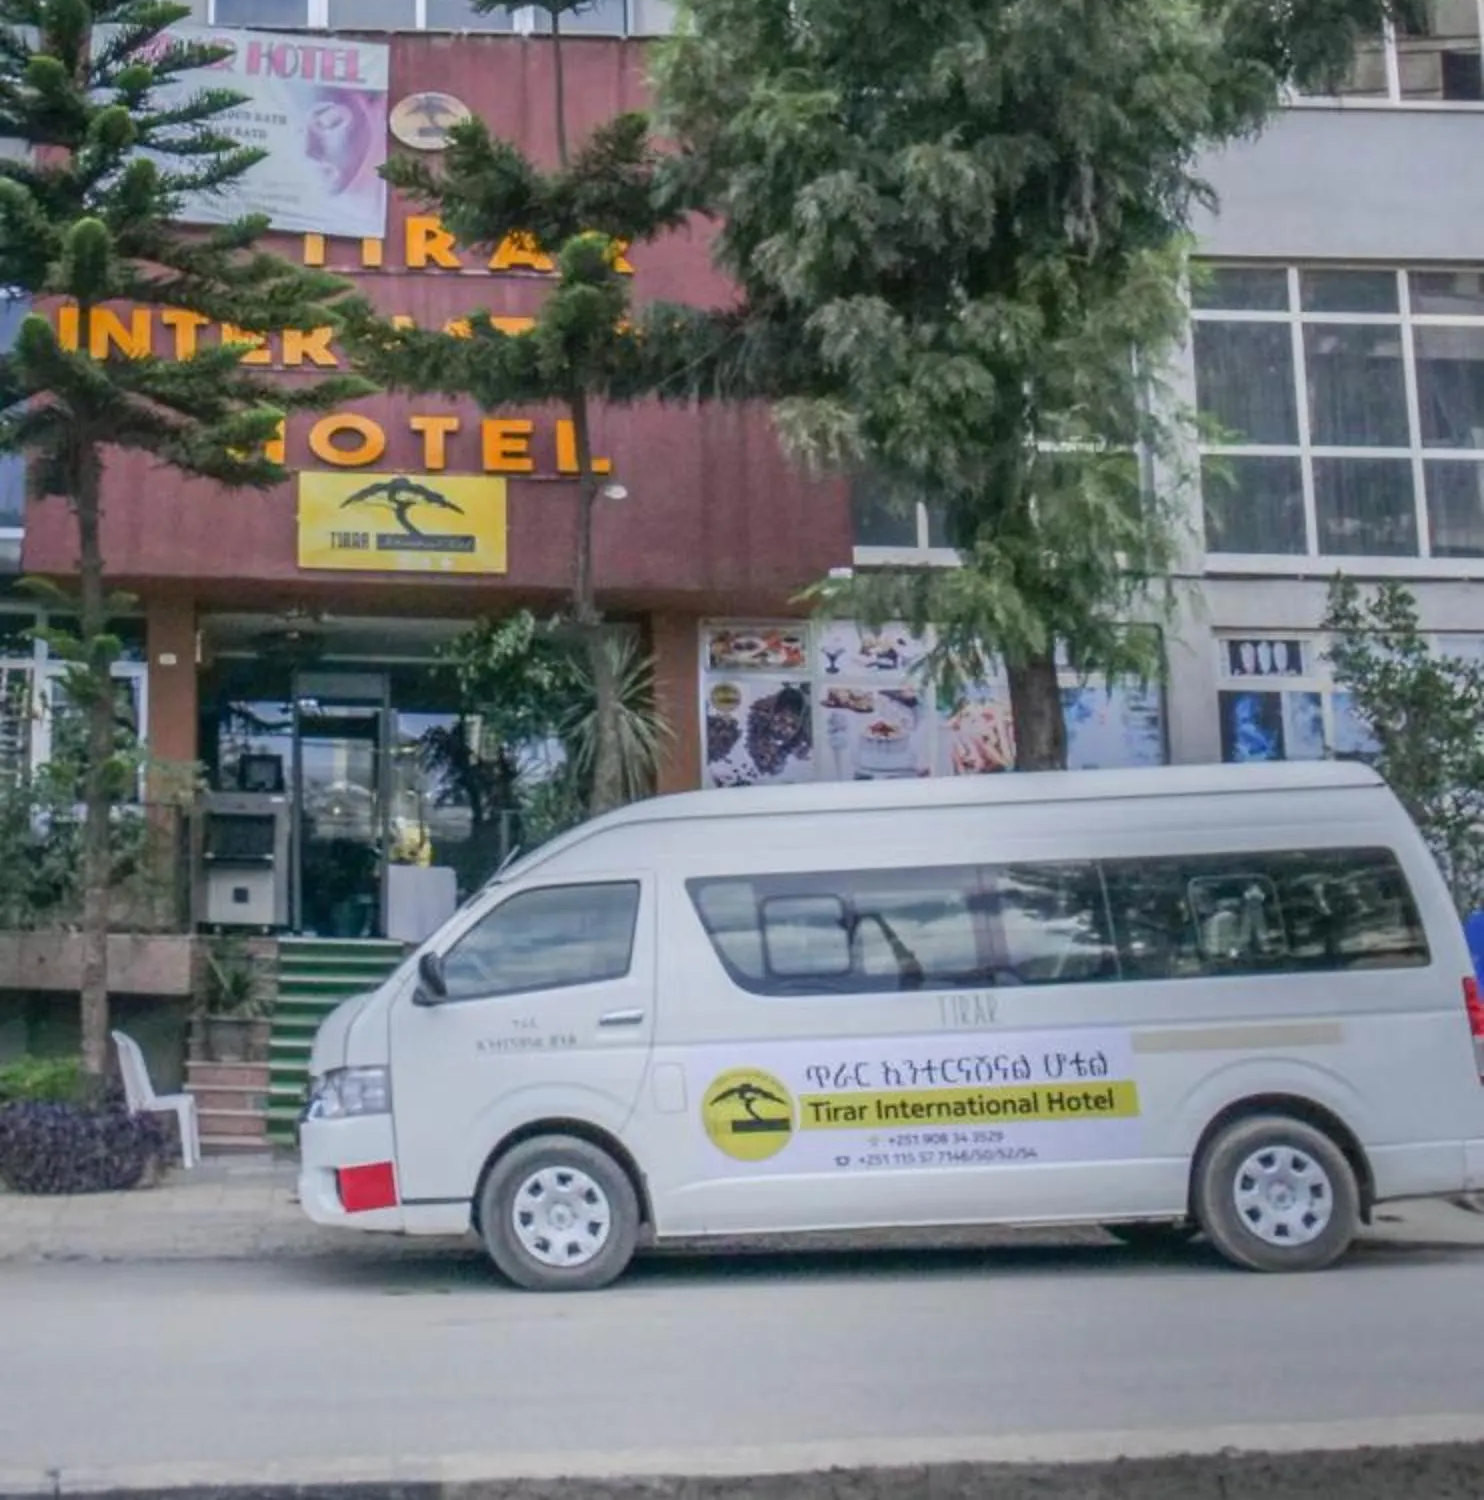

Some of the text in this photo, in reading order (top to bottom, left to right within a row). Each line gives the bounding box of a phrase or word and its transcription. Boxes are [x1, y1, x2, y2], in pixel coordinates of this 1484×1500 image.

[245, 40, 367, 84] HOTEL
[936, 993, 998, 1027] TIRAR
[807, 1087, 1115, 1122] Tirar International Hotel
[888, 1133, 919, 1146] +251
[858, 1153, 890, 1167] +251
